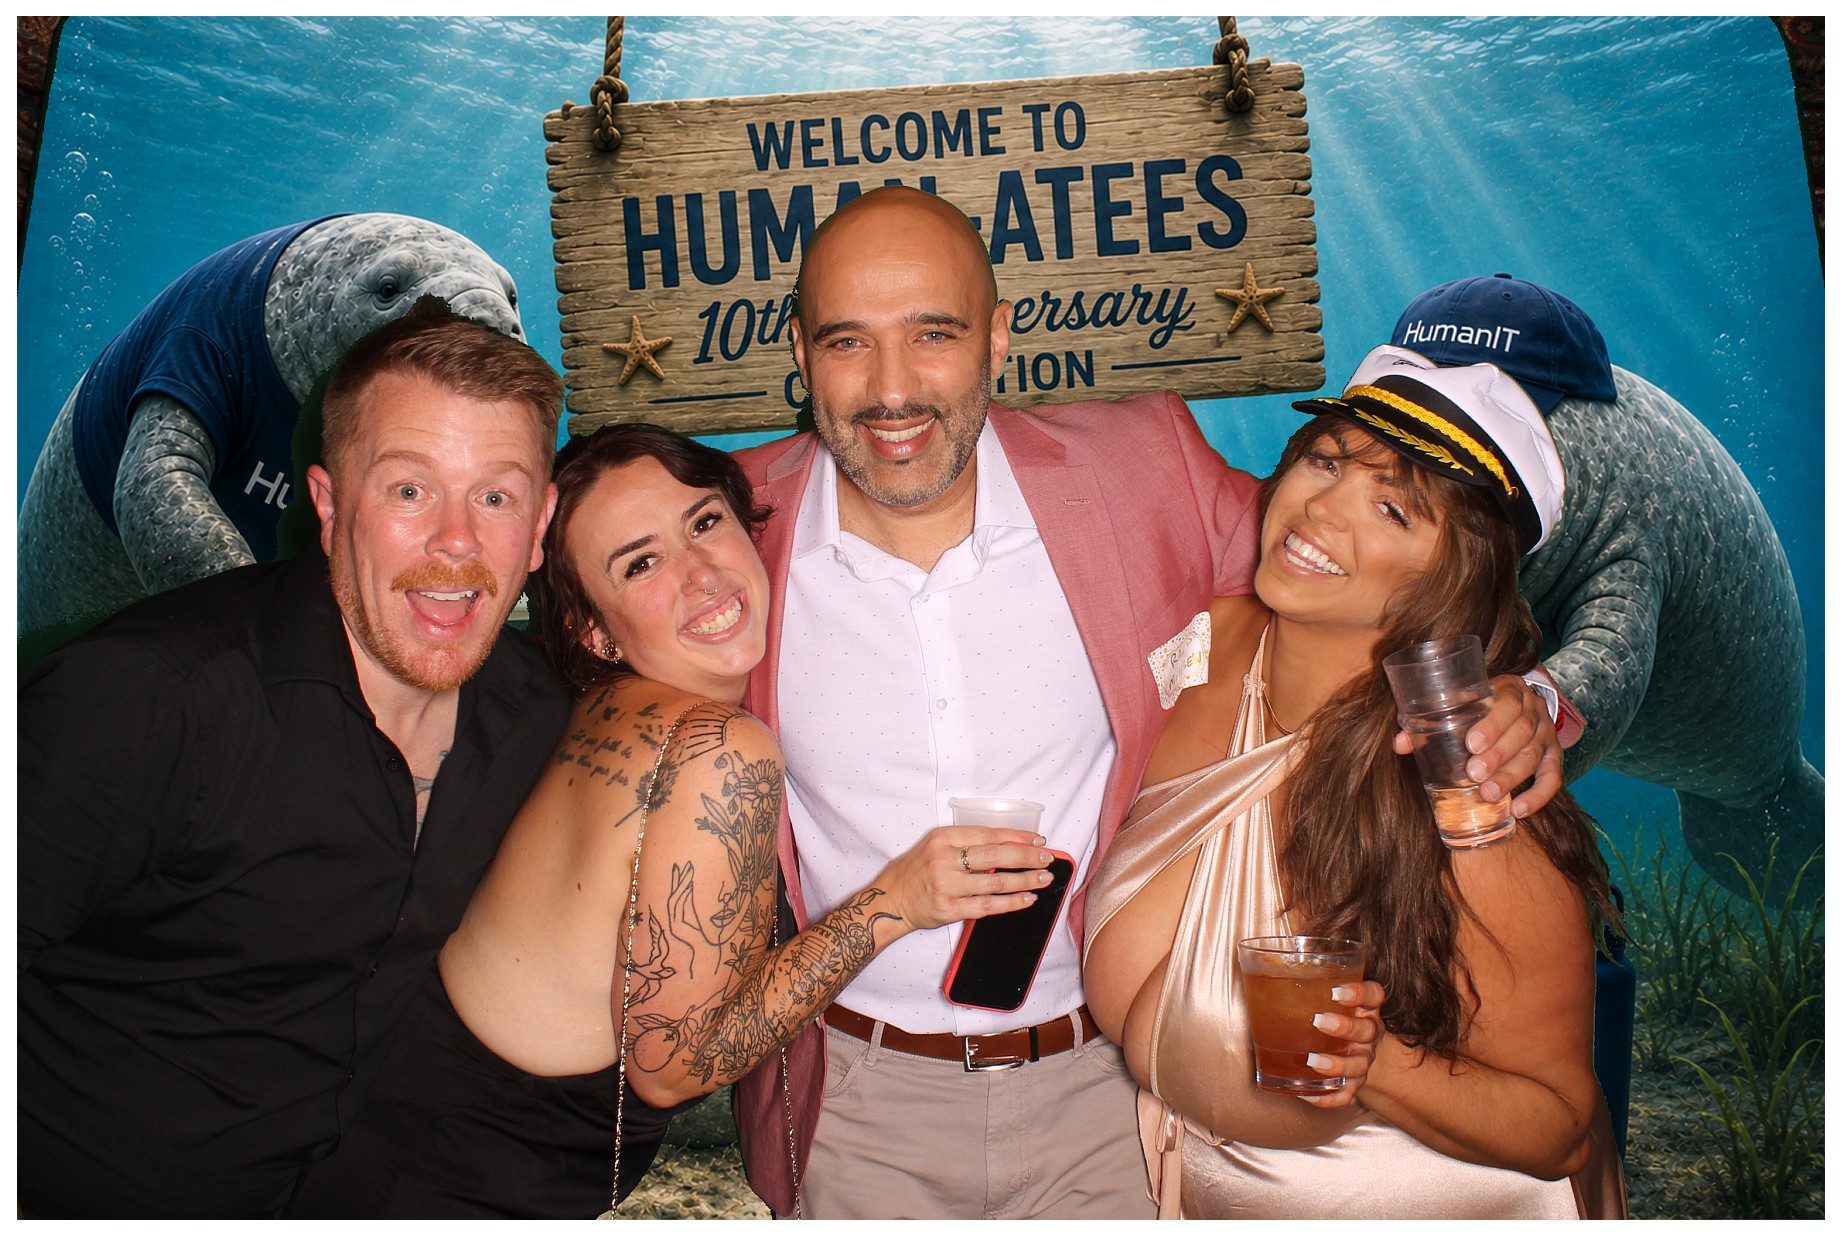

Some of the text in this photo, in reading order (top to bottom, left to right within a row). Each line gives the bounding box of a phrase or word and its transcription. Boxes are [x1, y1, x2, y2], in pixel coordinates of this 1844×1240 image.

[746, 101, 1086, 171] WELCOME TO
[622, 154, 1247, 290] HUMATEES
[693, 283, 1197, 364] 10th ersary
[1403, 320, 1520, 353] HumanIT
